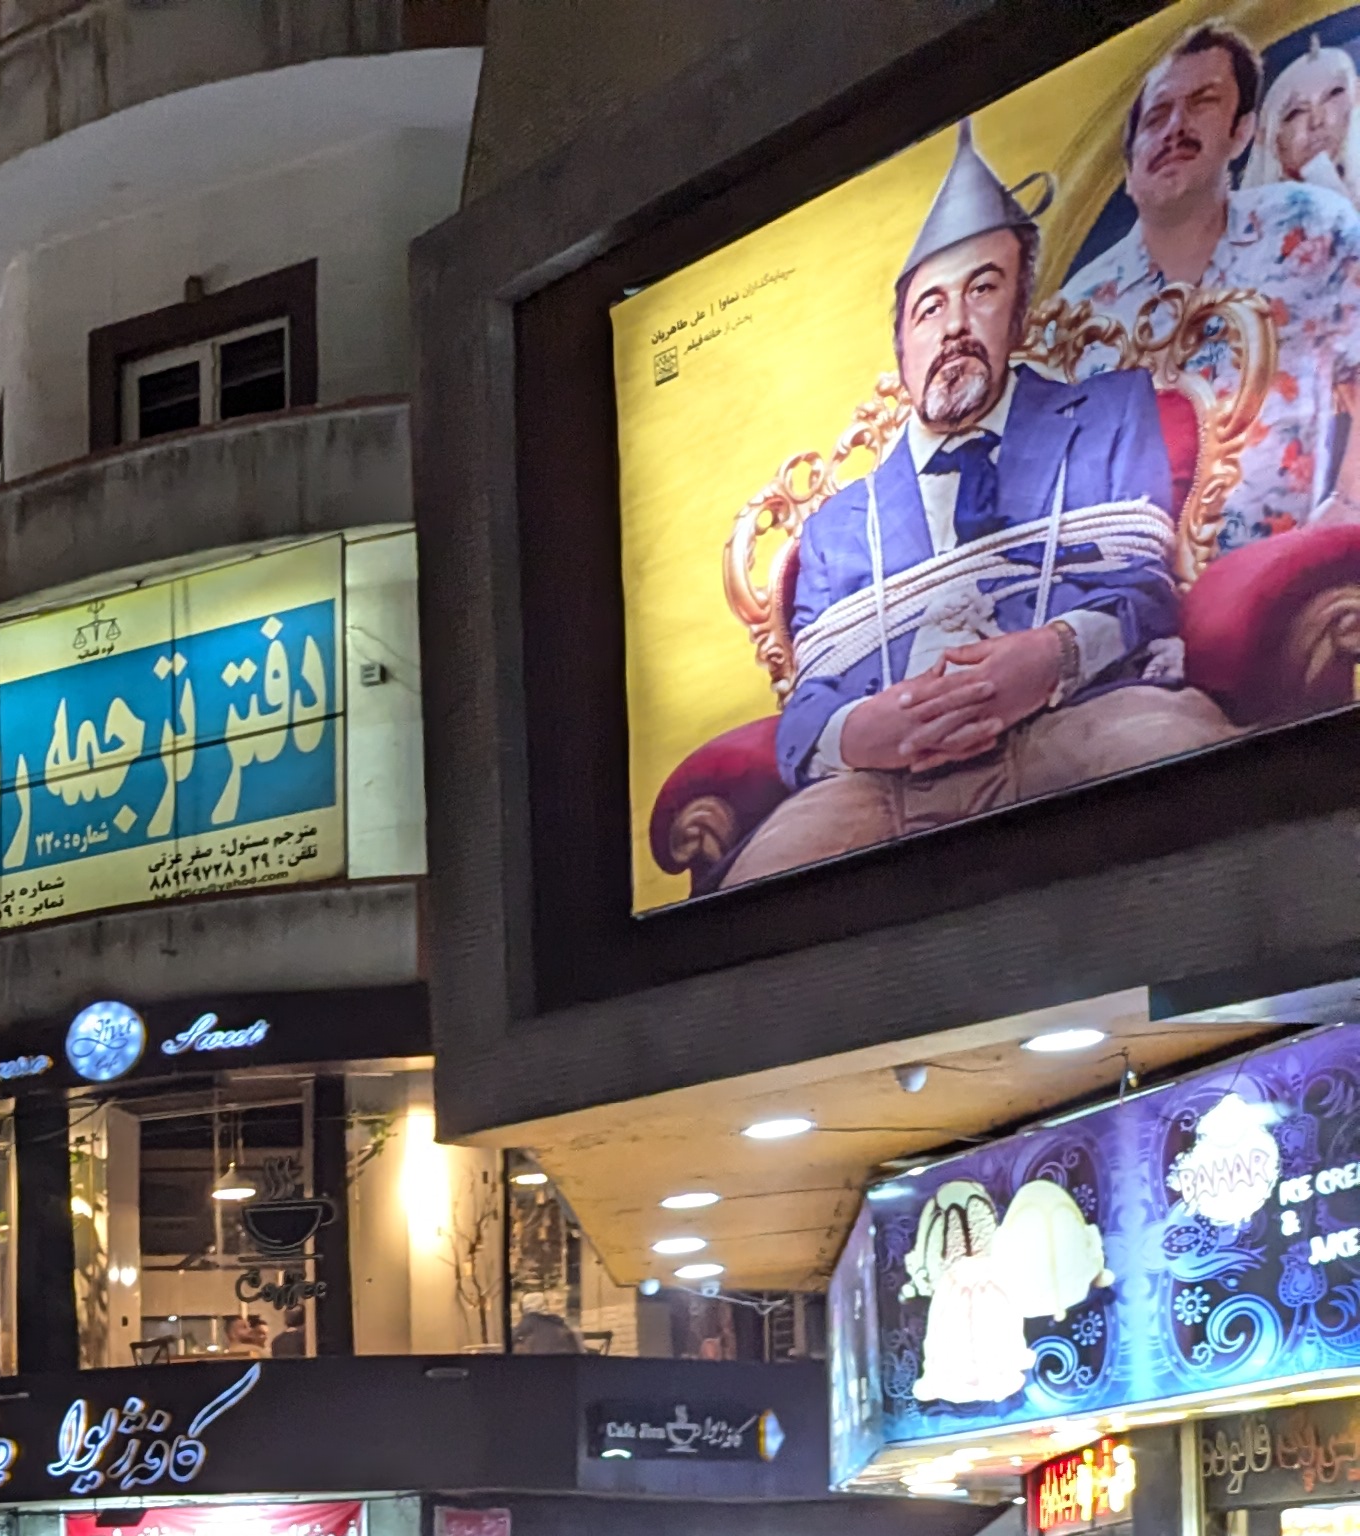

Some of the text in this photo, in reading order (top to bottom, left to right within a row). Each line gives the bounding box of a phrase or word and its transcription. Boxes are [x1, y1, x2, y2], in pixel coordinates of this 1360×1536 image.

[212, 615, 326, 824] دفتر
[45, 652, 196, 838] ترجمه
[273, 825, 318, 848] مترجم
[19, 876, 65, 899] شماره
[161, 1012, 271, 1055] Sweet
[1179, 1148, 1270, 1206] BAHAR
[1315, 1162, 1360, 1194] CRE
[236, 1266, 328, 1311] Coffee
